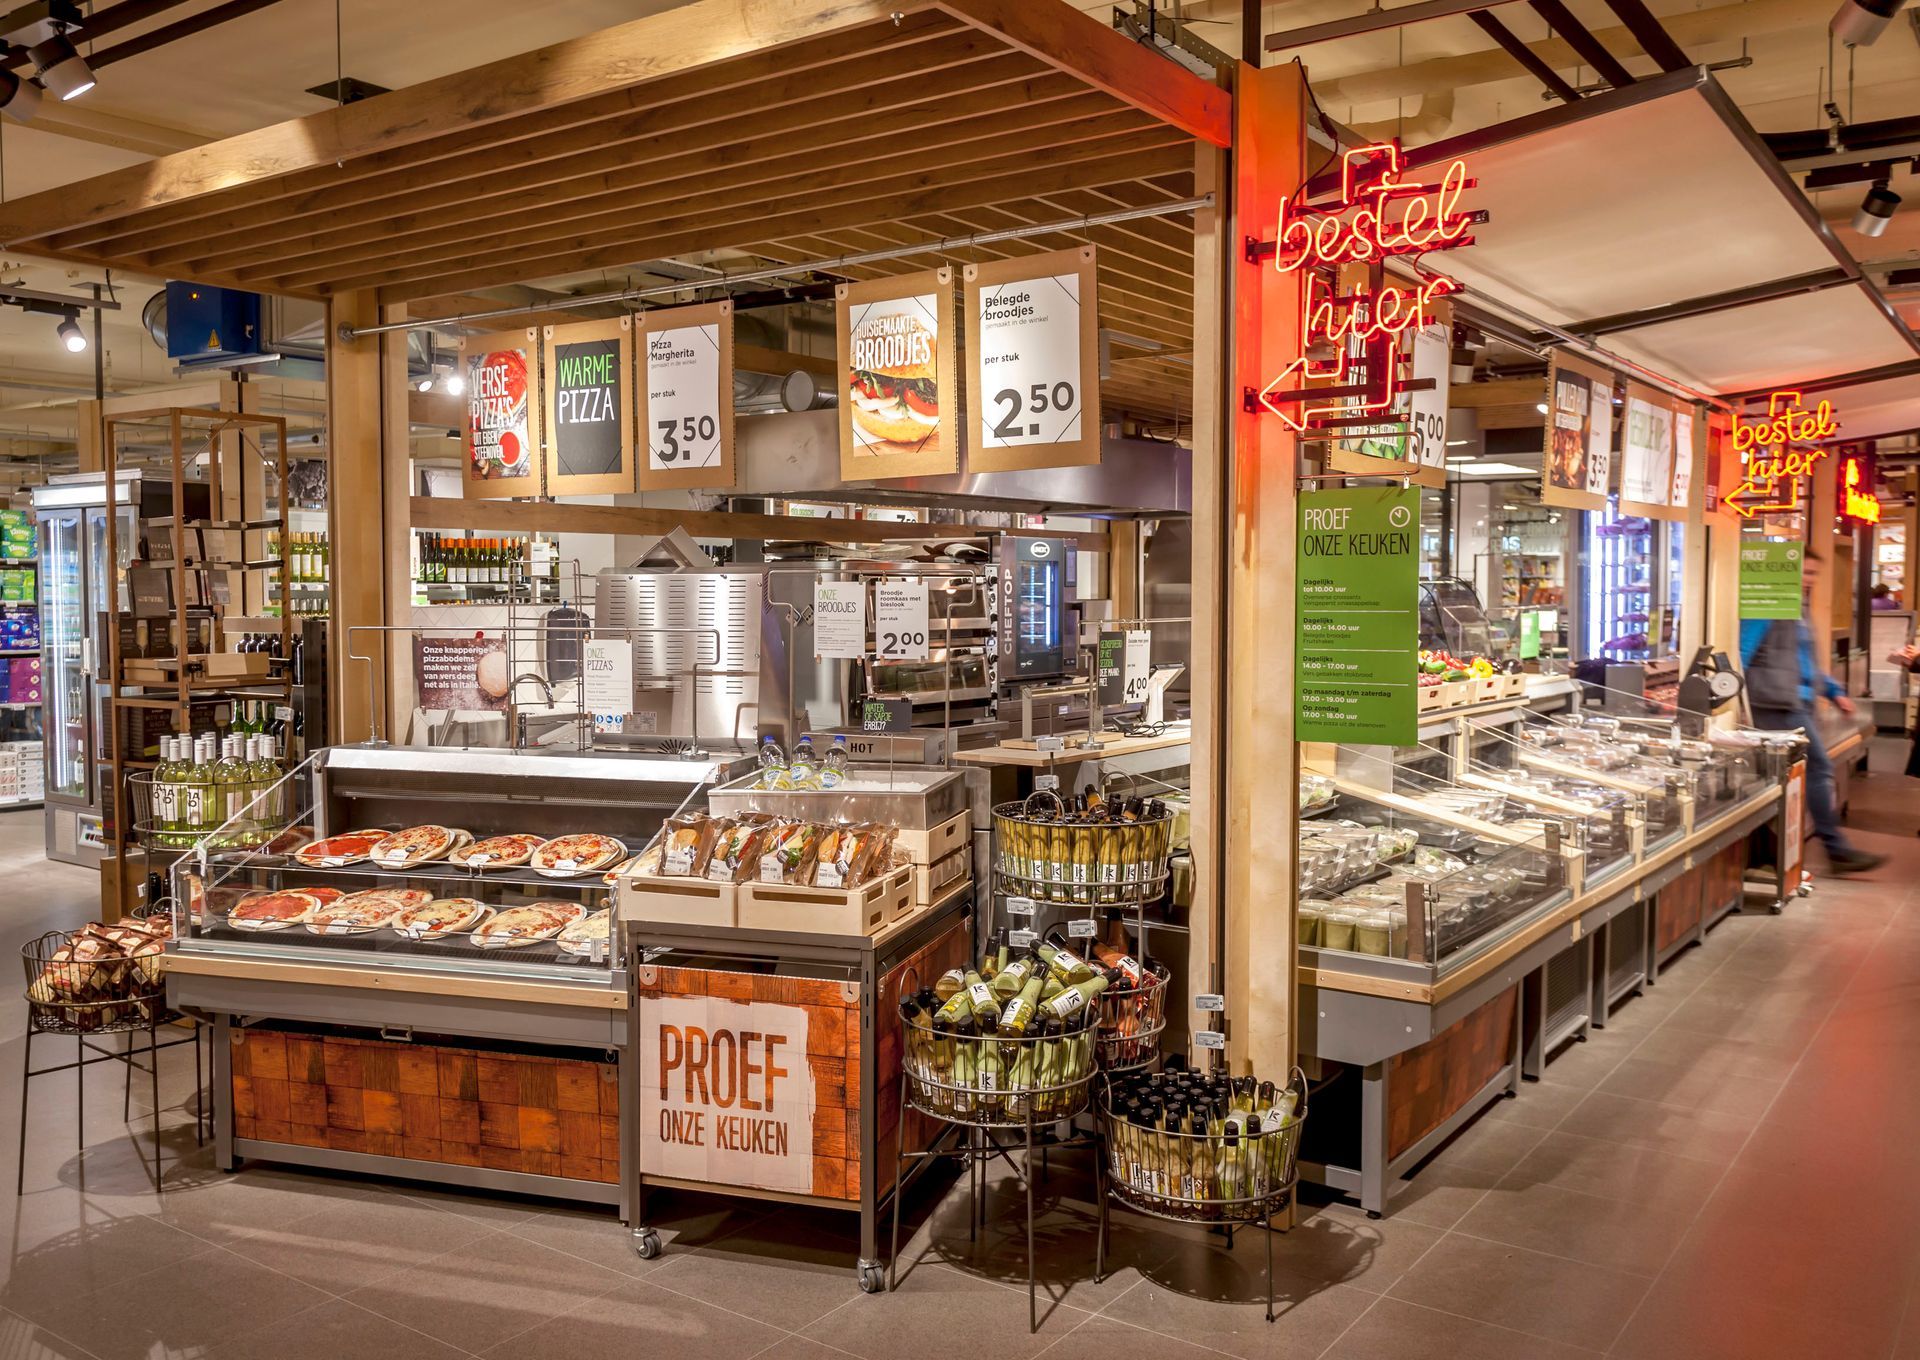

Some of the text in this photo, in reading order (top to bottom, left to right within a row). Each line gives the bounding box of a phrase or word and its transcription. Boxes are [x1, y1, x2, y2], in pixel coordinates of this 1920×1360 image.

[1275, 160, 1470, 272] bestel
[985, 291, 1030, 308] Belegde
[1304, 272, 1455, 347] hier
[985, 305, 1034, 321] broodjes
[1028, 315, 1049, 324] winkel
[857, 314, 916, 339] HUISGEMAAKTE
[651, 340, 672, 350] Pizza
[651, 348, 695, 362] Margherita
[855, 332, 931, 371] BROODJES
[984, 353, 1020, 365] per stuk
[472, 364, 509, 399] VERSE
[559, 354, 615, 388] WARME
[662, 389, 676, 398] stuk
[472, 397, 514, 431] PIZZA'S
[558, 387, 615, 424] PIZZA
[1732, 399, 1837, 451] bestel
[1748, 447, 1828, 482] hier
[1304, 508, 1353, 531] PROEF
[1304, 532, 1410, 557] ONZE KEUKEN
[818, 589, 838, 601] ONZE
[818, 602, 857, 614] BROODJES
[1004, 568, 1014, 655] CHEFTOP
[423, 646, 489, 656] Onze knapperige
[587, 648, 606, 659] ONZE
[882, 632, 925, 655] 2.00
[587, 660, 614, 671] PIZZA'S
[457, 673, 477, 681] deeg
[1126, 678, 1147, 699] 4.00
[1361, 690, 1392, 698] zaterdag
[865, 704, 885, 713] WATER
[850, 743, 874, 754] HOT
[659, 1024, 788, 1113] PROEF
[659, 1108, 788, 1157] ONZE KEUKEN
